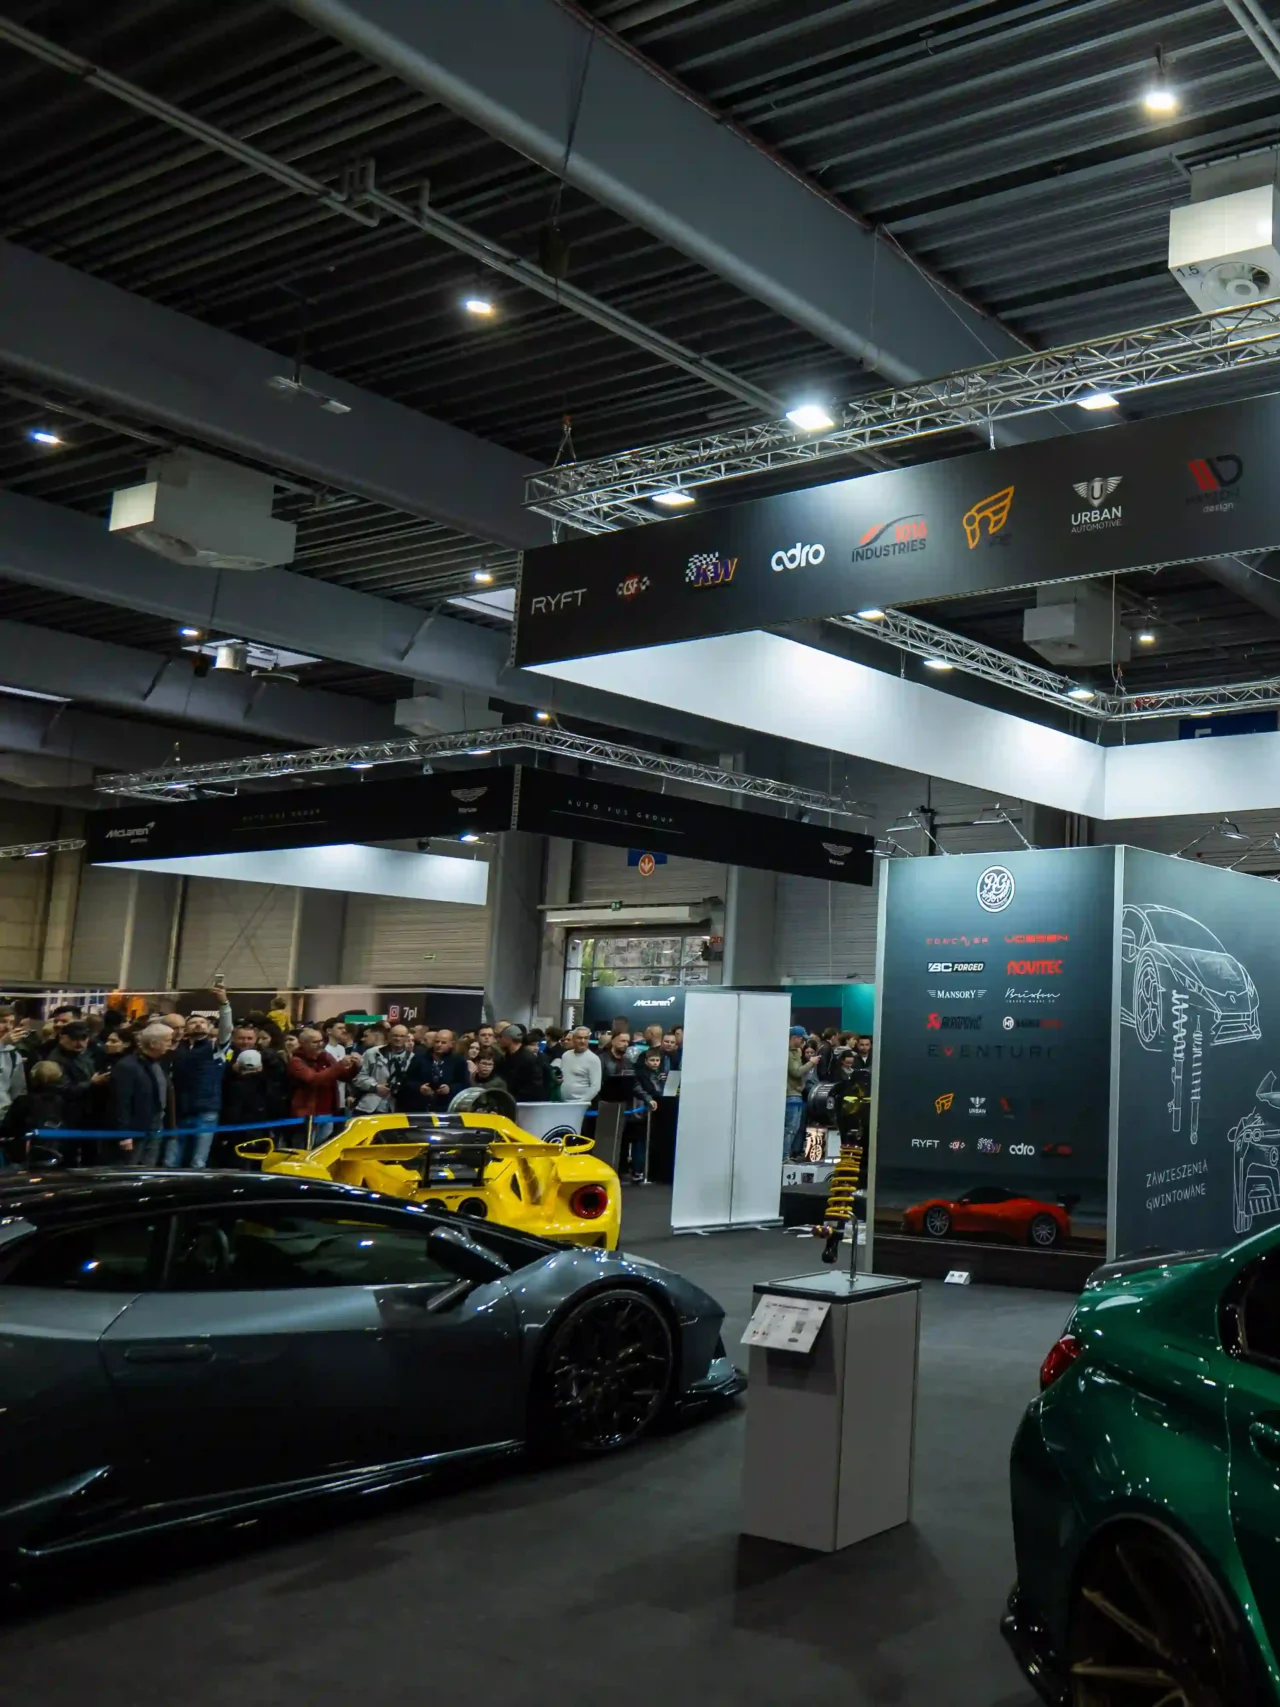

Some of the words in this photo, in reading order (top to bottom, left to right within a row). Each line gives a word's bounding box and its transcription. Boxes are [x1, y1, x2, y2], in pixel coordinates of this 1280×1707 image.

[1176, 264, 1200, 278] 1.5
[1203, 502, 1234, 513] design
[1071, 506, 1122, 526] URBAN
[1070, 519, 1122, 534] AUTOMOTIVE
[770, 542, 826, 572] adro
[851, 538, 927, 563] INDUSTRIES
[694, 557, 738, 587] KW
[531, 588, 587, 615] RYFT
[567, 799, 599, 810] AUTO
[636, 811, 673, 823] GROUP
[104, 827, 149, 839] McLaren
[953, 962, 984, 971] FORGED
[1007, 959, 1063, 975] NOVITEC
[937, 989, 976, 998] MANSORY
[633, 998, 672, 1007] McLaren
[911, 1139, 940, 1149] RYFT
[1145, 1159, 1208, 1188] ZAWIESZENIA
[1145, 1182, 1207, 1212] GWINTOWANE
